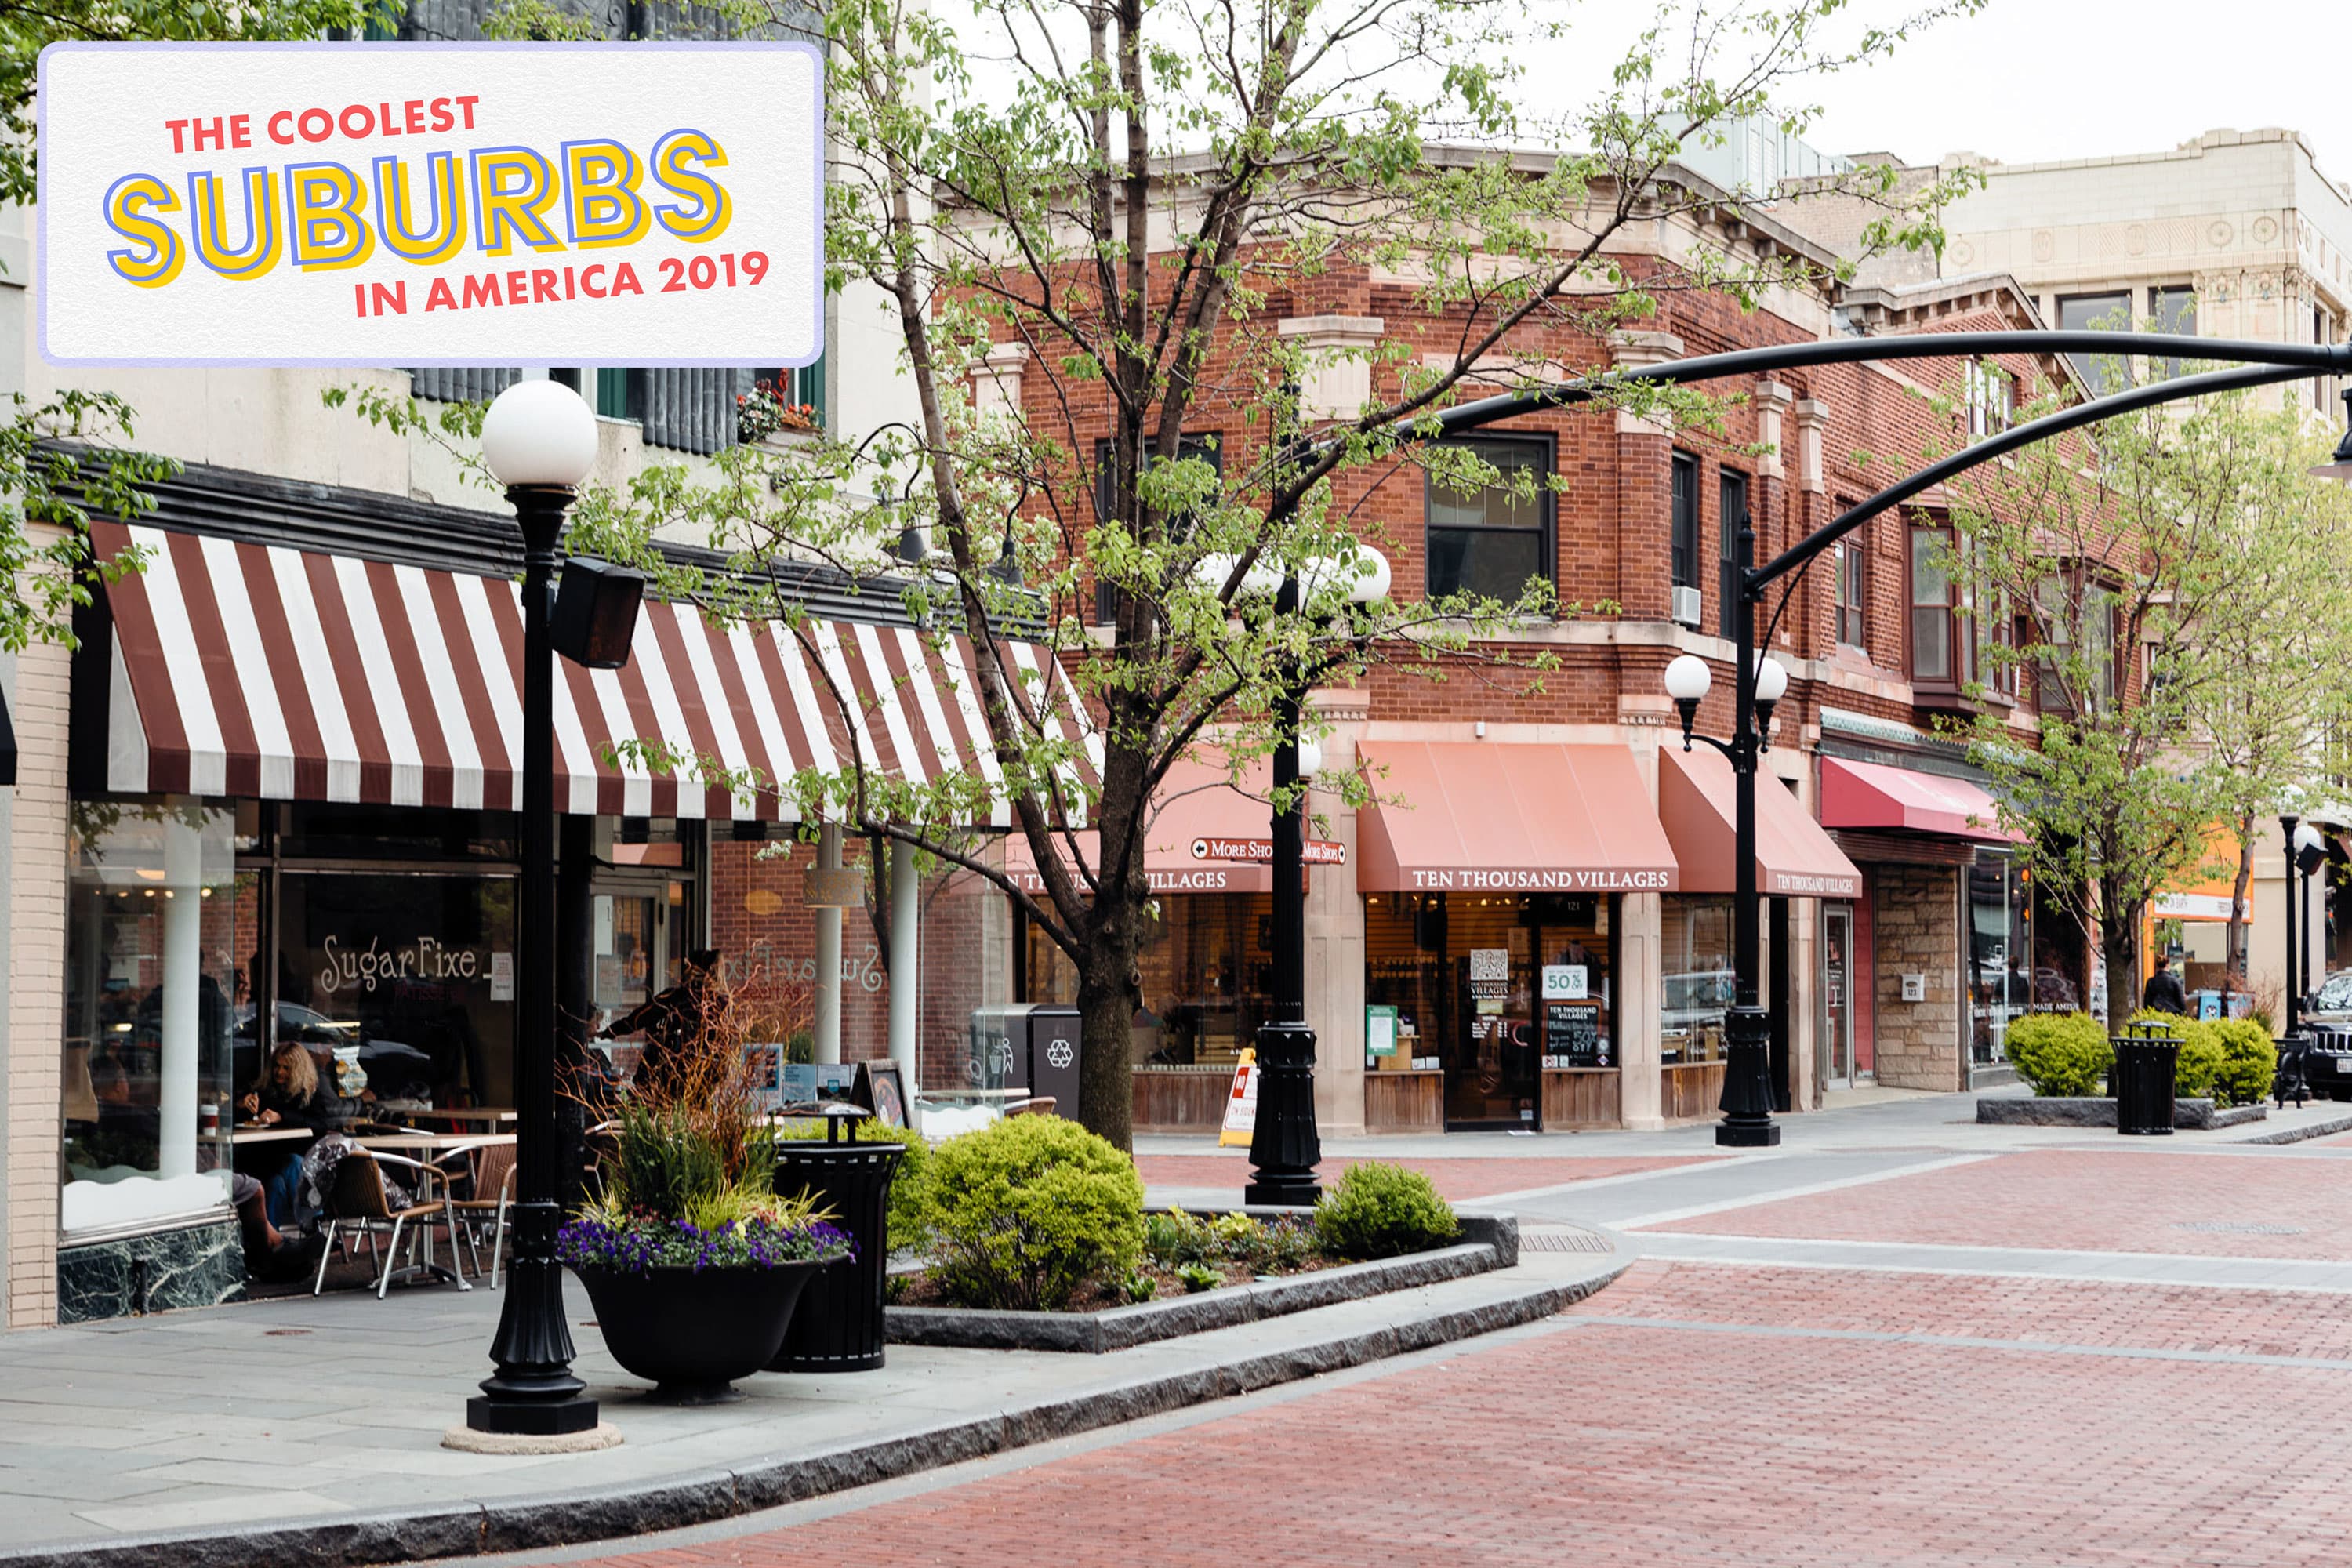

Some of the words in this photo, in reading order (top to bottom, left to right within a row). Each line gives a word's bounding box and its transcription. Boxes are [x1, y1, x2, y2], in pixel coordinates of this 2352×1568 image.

[1210, 840, 1245, 857] MORE
[1247, 841, 1273, 857] SHO
[1303, 842, 1320, 858] MORE
[1322, 844, 1338, 860] SHOPS
[982, 873, 1019, 890] TN
[1145, 872, 1226, 889] ILLAGES
[1413, 871, 1454, 887] TEN
[1458, 871, 1572, 887] THOUSAND
[1576, 871, 1668, 887] VILLAGES
[1777, 873, 1791, 890] TEN
[1791, 875, 1825, 891] THOUSAND
[1824, 877, 1853, 894] VILLAGES
[321, 935, 415, 993] Sugar
[418, 936, 476, 978] Fixe
[1471, 986, 1509, 995] VILLAGES
[1549, 1006, 1563, 1014] TEN
[1563, 1006, 1597, 1014] THOUSAND
[2034, 1003, 2053, 1011] MADE
